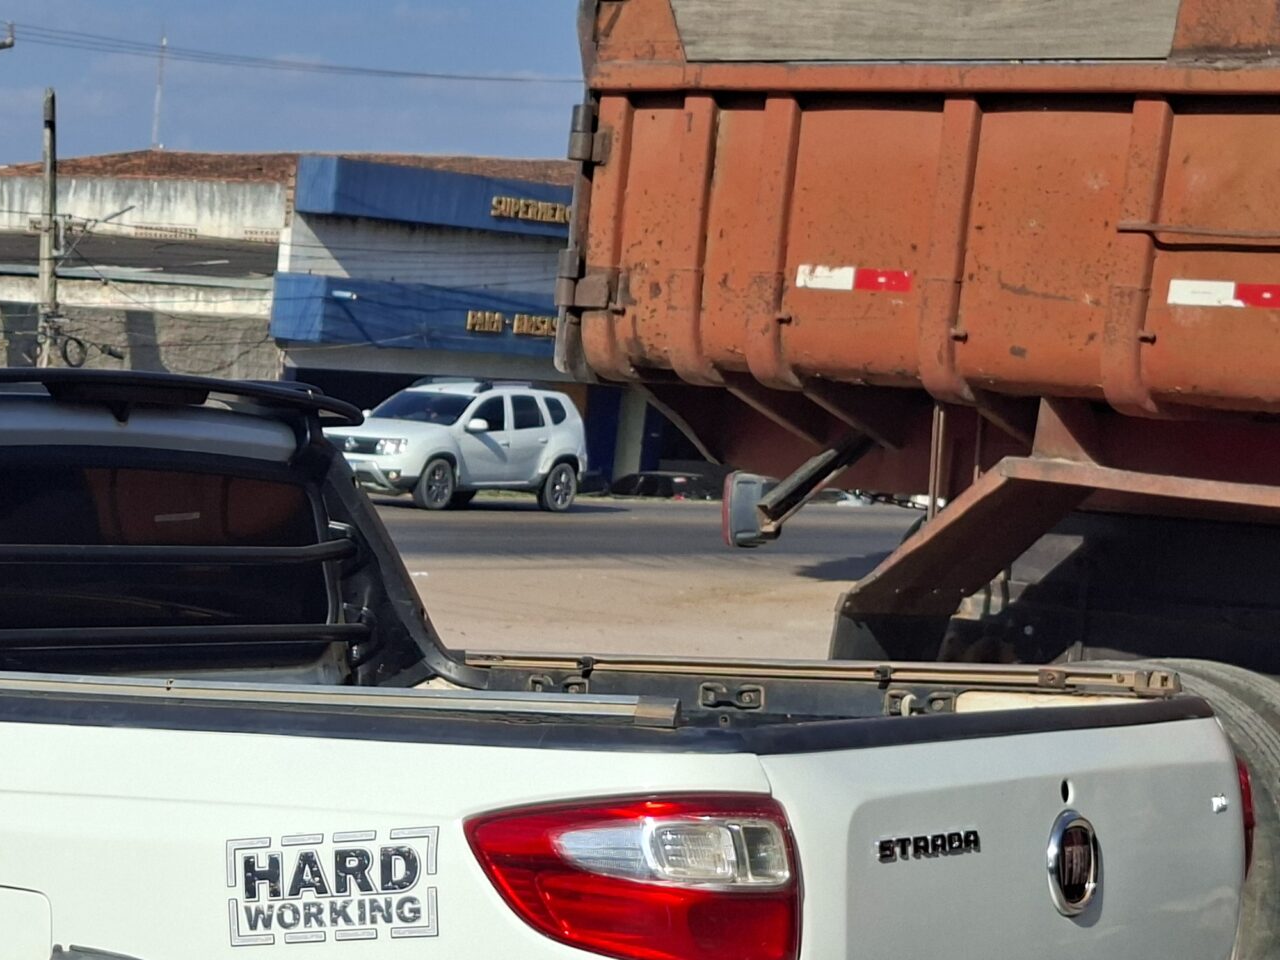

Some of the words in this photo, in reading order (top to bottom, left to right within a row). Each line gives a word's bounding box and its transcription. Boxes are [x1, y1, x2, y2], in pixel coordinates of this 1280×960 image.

[878, 830, 981, 863] STRADA
[242, 847, 420, 901] HARD
[243, 896, 422, 931] WORKING
